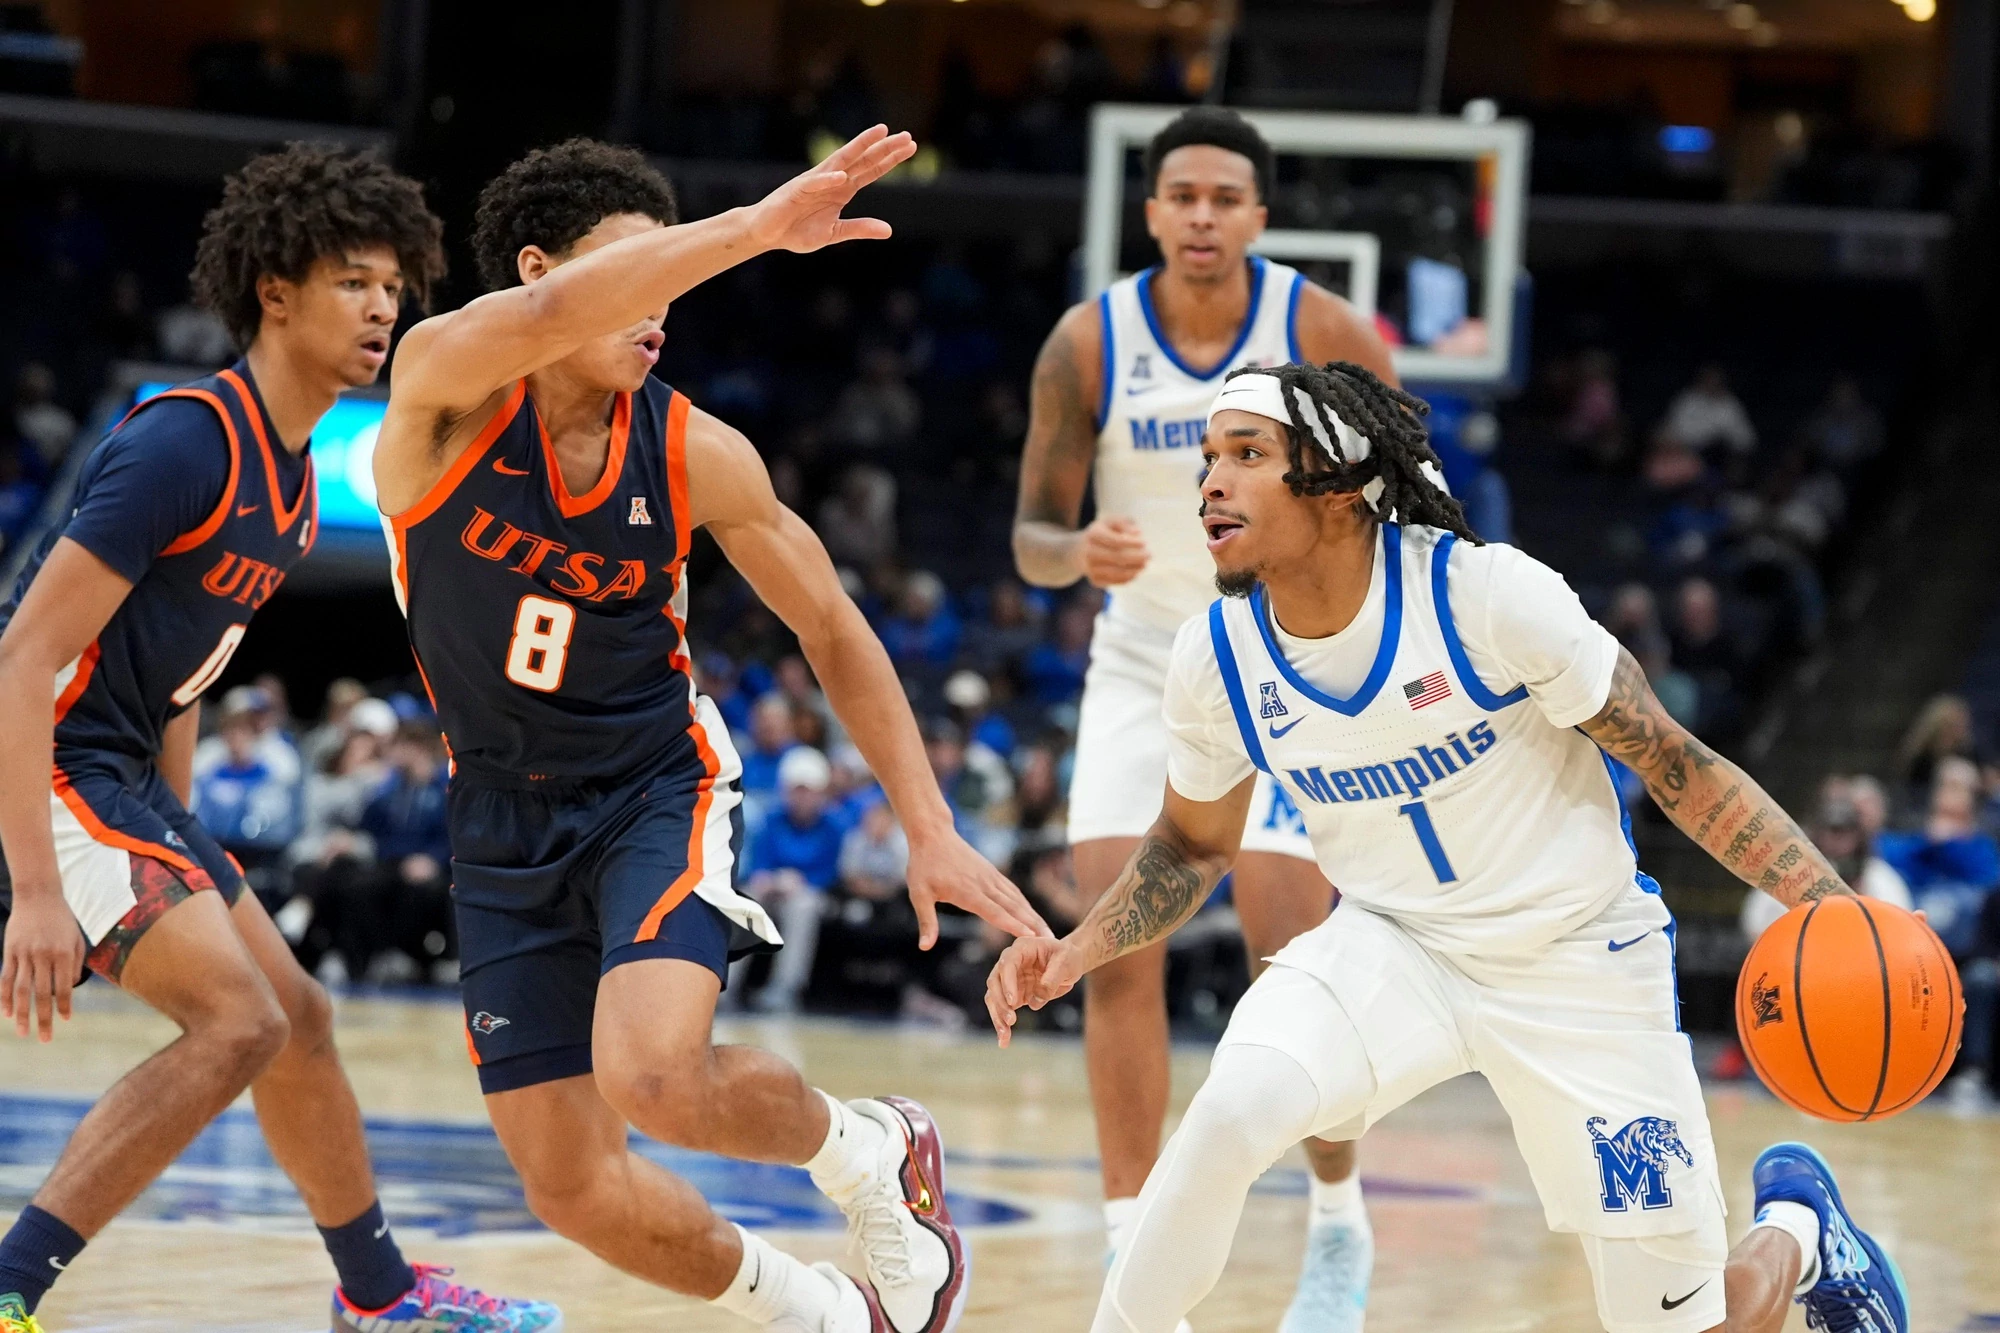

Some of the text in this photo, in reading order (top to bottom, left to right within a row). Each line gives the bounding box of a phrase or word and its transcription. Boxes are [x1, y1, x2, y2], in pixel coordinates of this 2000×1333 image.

[461, 505, 646, 602] UTSA
[504, 594, 576, 693] 8
[1259, 681, 1288, 719] A
[1282, 718, 1497, 805] Memphis
[1398, 800, 1459, 885] 1
[1773, 845, 1796, 865] WHO
[1780, 849, 1803, 871] YOU
[1592, 1138, 1673, 1212] M
